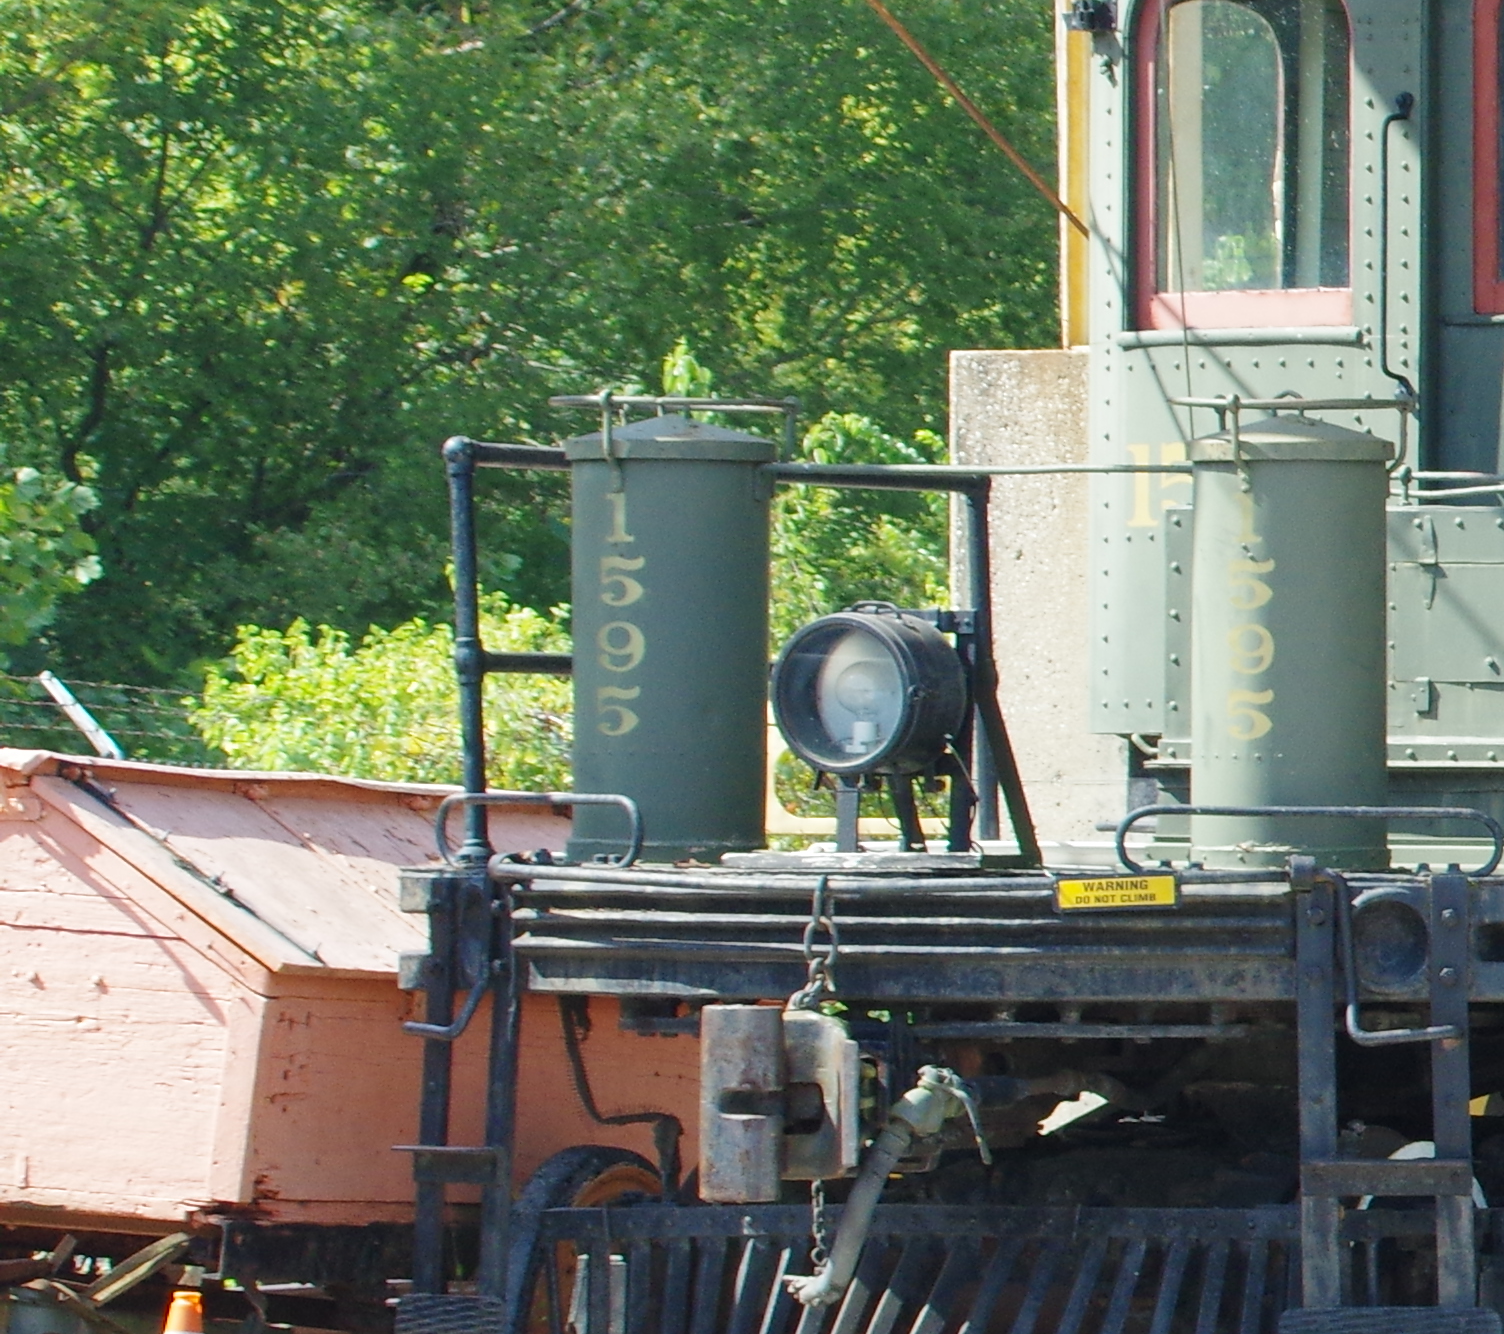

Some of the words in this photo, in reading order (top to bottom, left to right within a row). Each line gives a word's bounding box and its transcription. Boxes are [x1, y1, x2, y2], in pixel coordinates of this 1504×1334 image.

[597, 492, 646, 737] 1595
[1227, 492, 1276, 741] 1595
[1075, 896, 1090, 904] DO
[1094, 895, 1116, 903] NOT
[1120, 893, 1156, 902] CLIMB
[1083, 880, 1148, 893] WARNING
